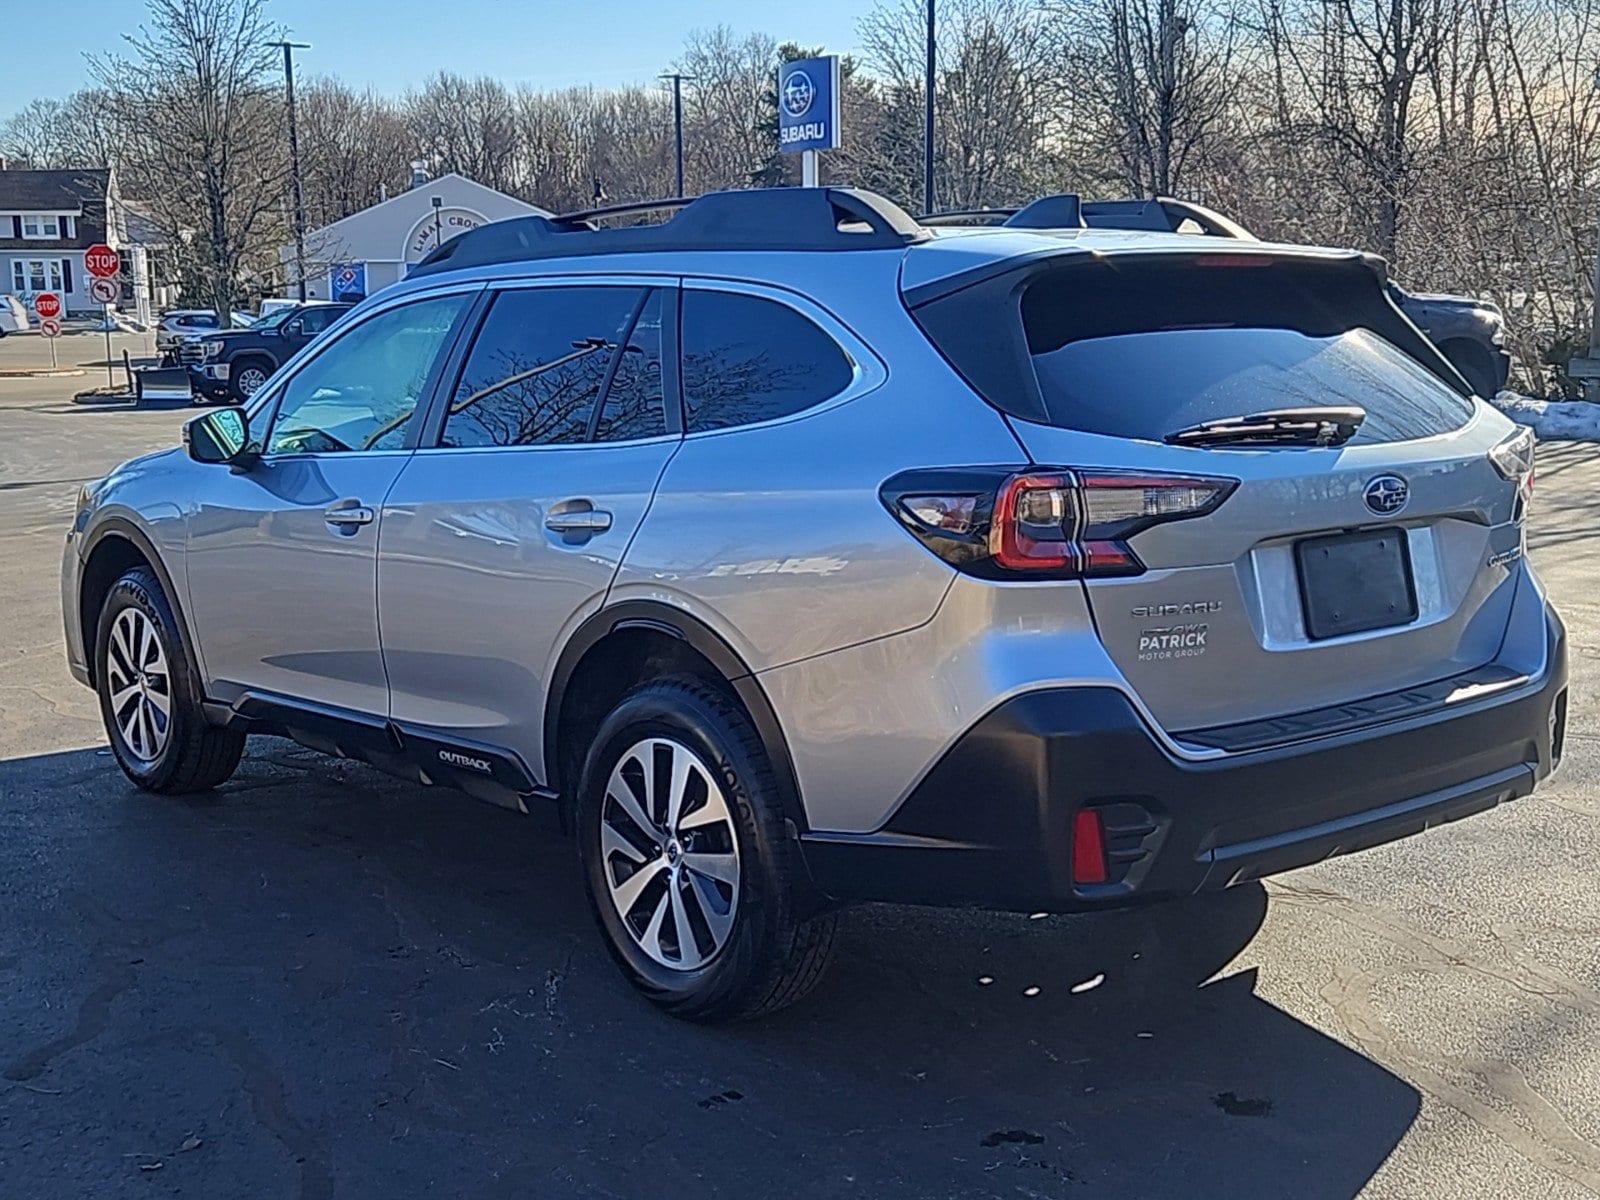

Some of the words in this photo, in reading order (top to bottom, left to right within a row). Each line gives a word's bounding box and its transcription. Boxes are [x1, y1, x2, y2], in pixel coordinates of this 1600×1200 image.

[781, 122, 825, 144] SUBARU
[87, 255, 117, 268] STOP
[37, 301, 58, 311] STOP
[1131, 600, 1222, 617] SUBARU
[1139, 631, 1207, 651] PATRICK
[1138, 651, 1171, 661] MOTOR
[1174, 648, 1206, 658] GROUP
[438, 750, 492, 773] OUTBACK
